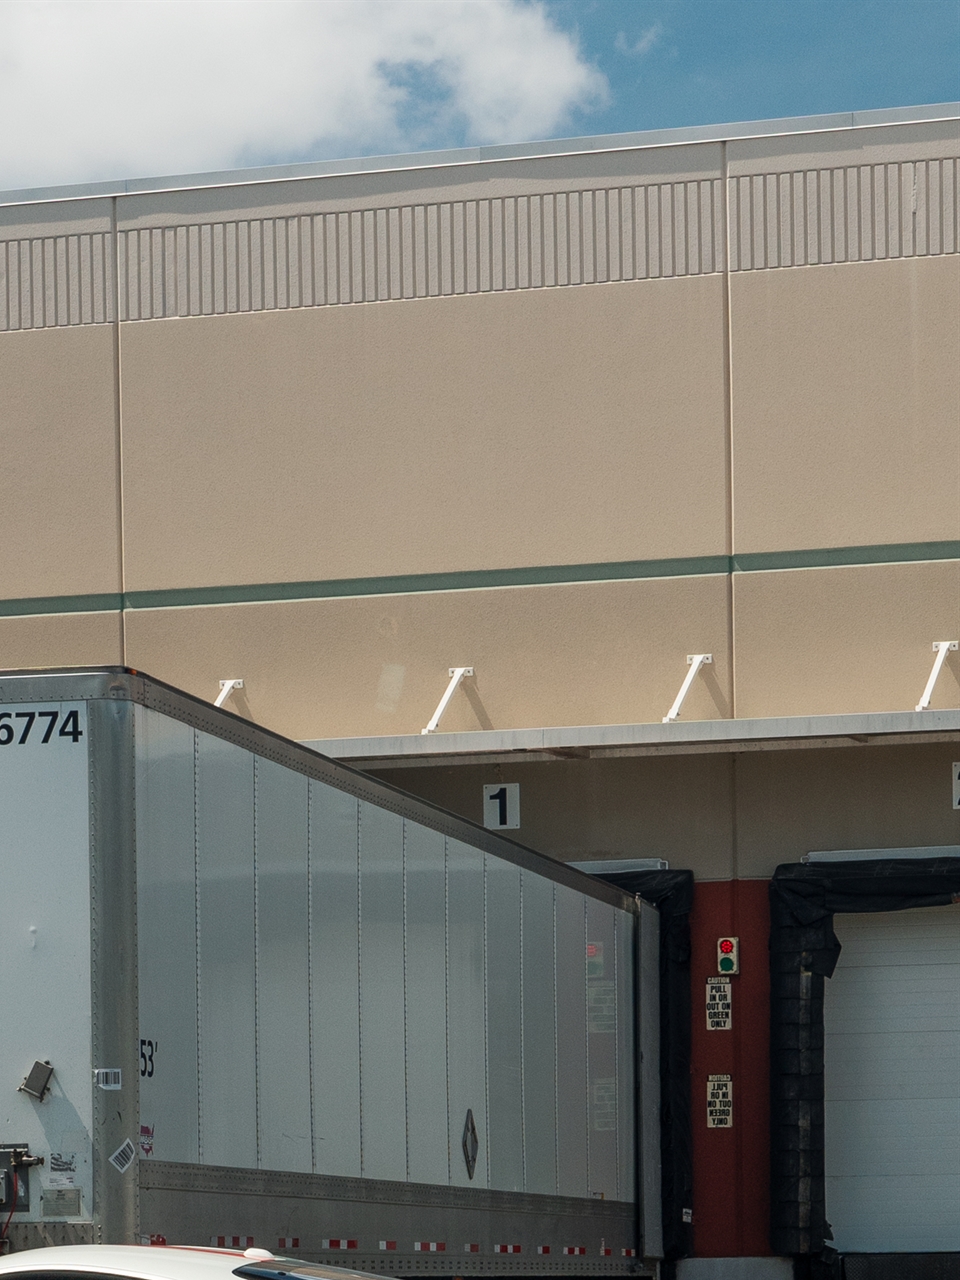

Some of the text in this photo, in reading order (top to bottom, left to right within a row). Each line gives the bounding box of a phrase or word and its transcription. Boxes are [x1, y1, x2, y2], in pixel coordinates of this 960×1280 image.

[489, 787, 507, 826] 1
[707, 976, 730, 984] CAUTION
[710, 985, 727, 993] PULL
[710, 994, 728, 1002] IN OR
[706, 1002, 731, 1011] OUT ON
[708, 1011, 730, 1020] GREEN
[710, 1020, 727, 1028] ONLY
